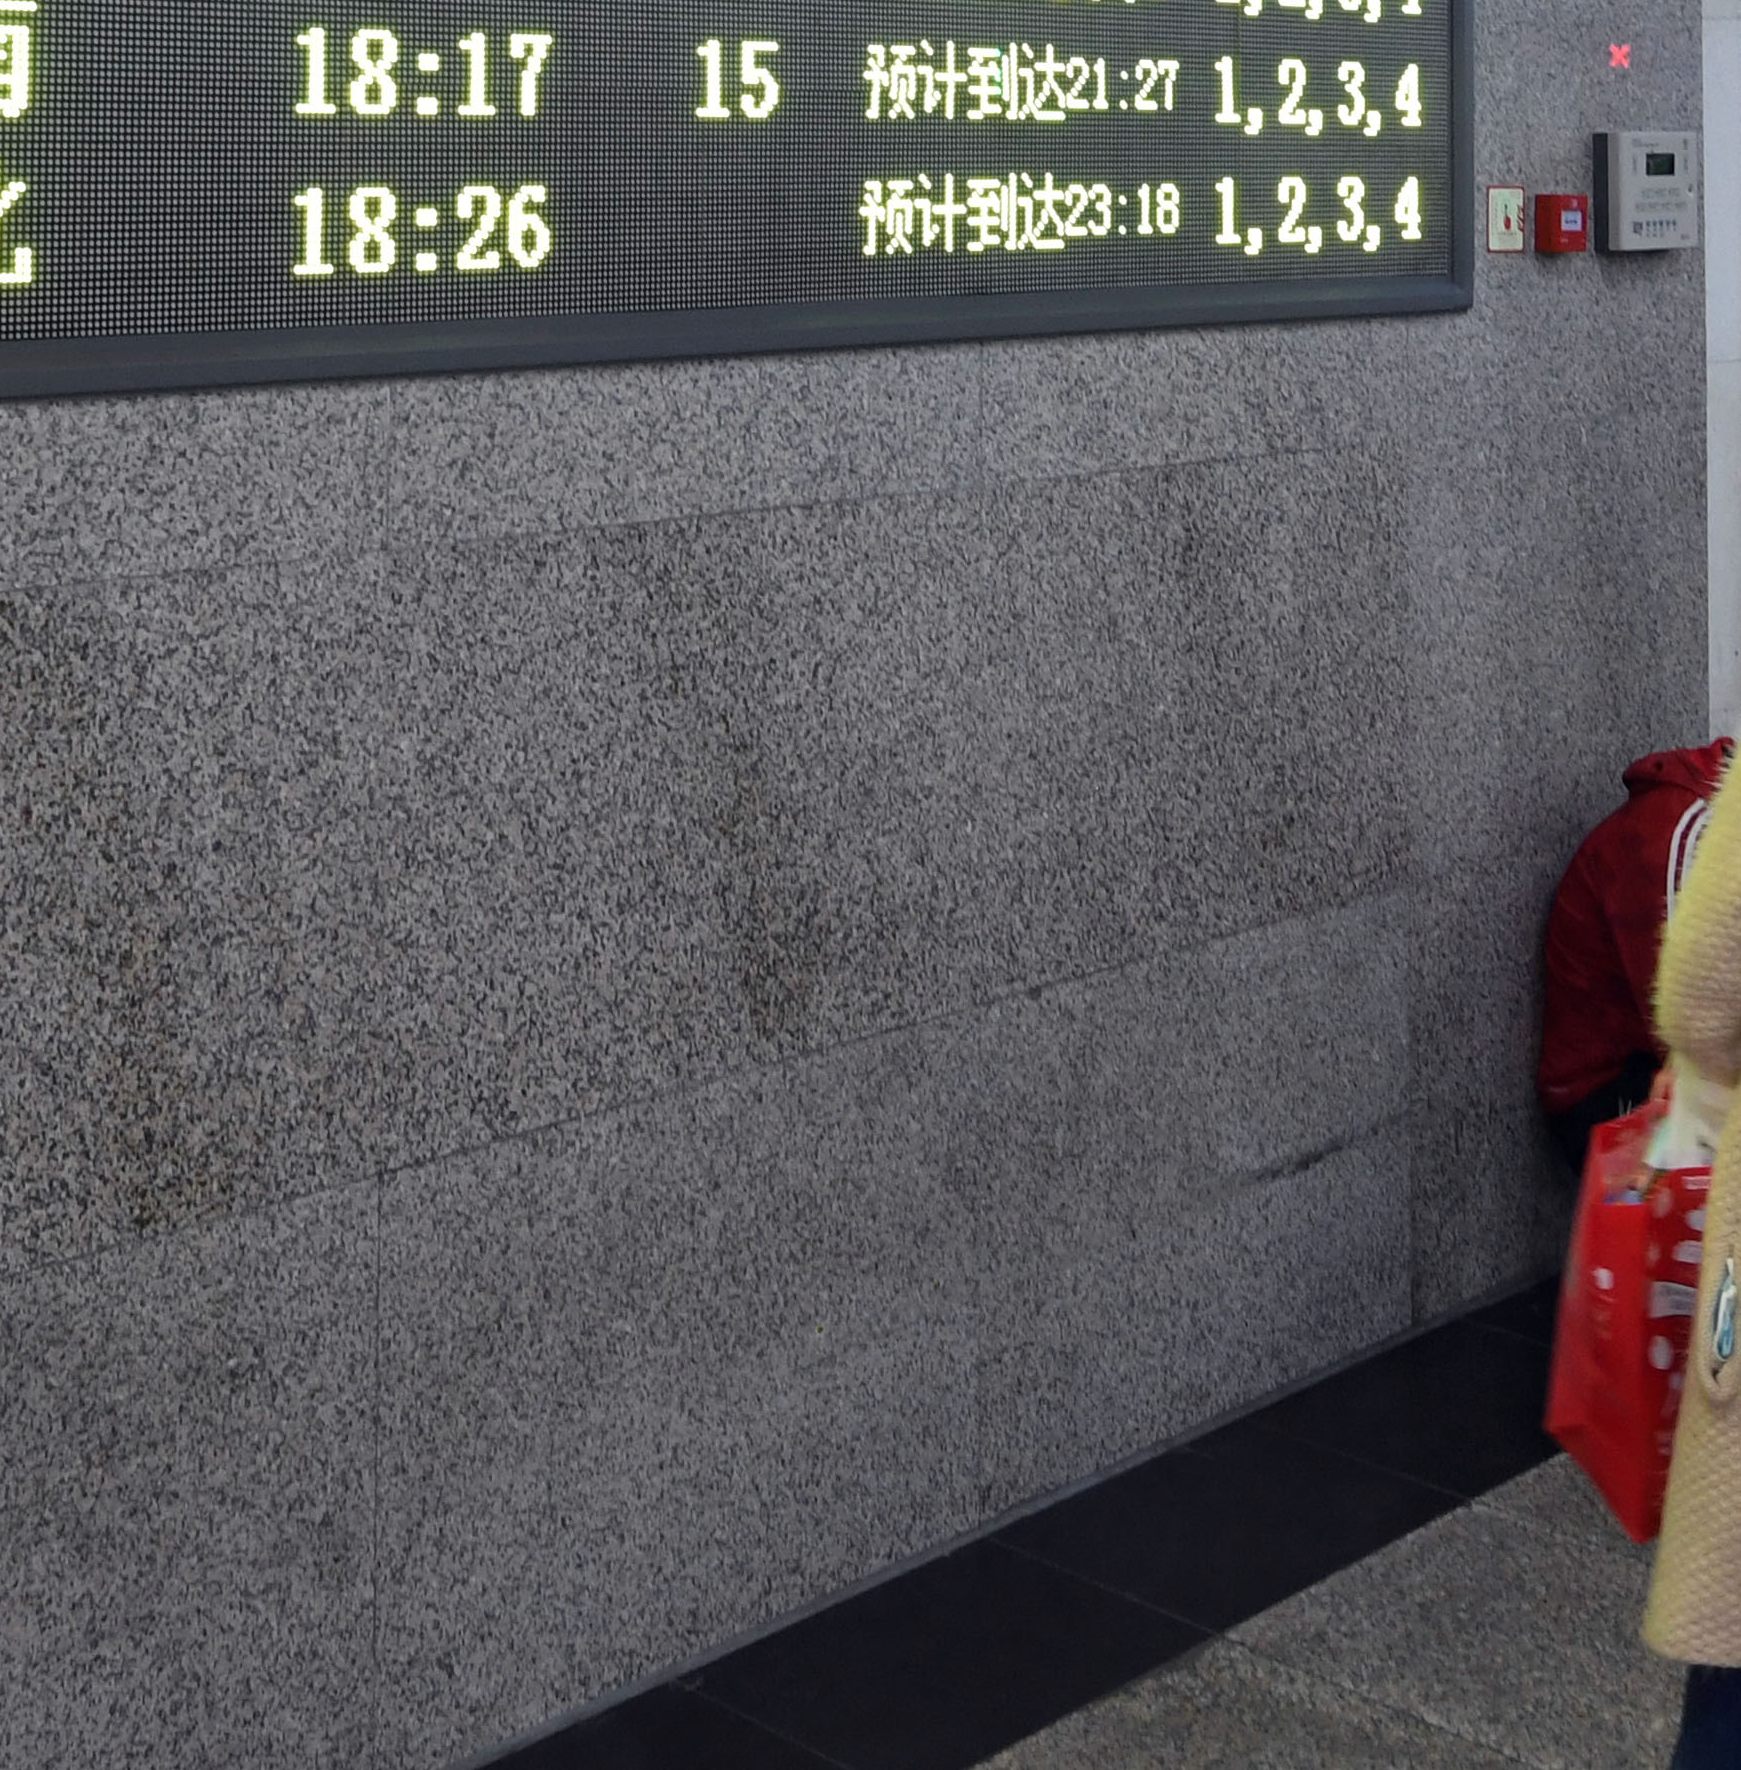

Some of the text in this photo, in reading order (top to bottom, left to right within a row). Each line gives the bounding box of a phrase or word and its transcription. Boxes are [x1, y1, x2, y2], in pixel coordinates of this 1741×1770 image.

[294, 26, 554, 117] 18:17
[694, 38, 780, 120] 15
[1213, 55, 1423, 138] 1,2,3,4
[292, 184, 551, 276] 18:26
[1214, 175, 1423, 256] 1,2,3,4
